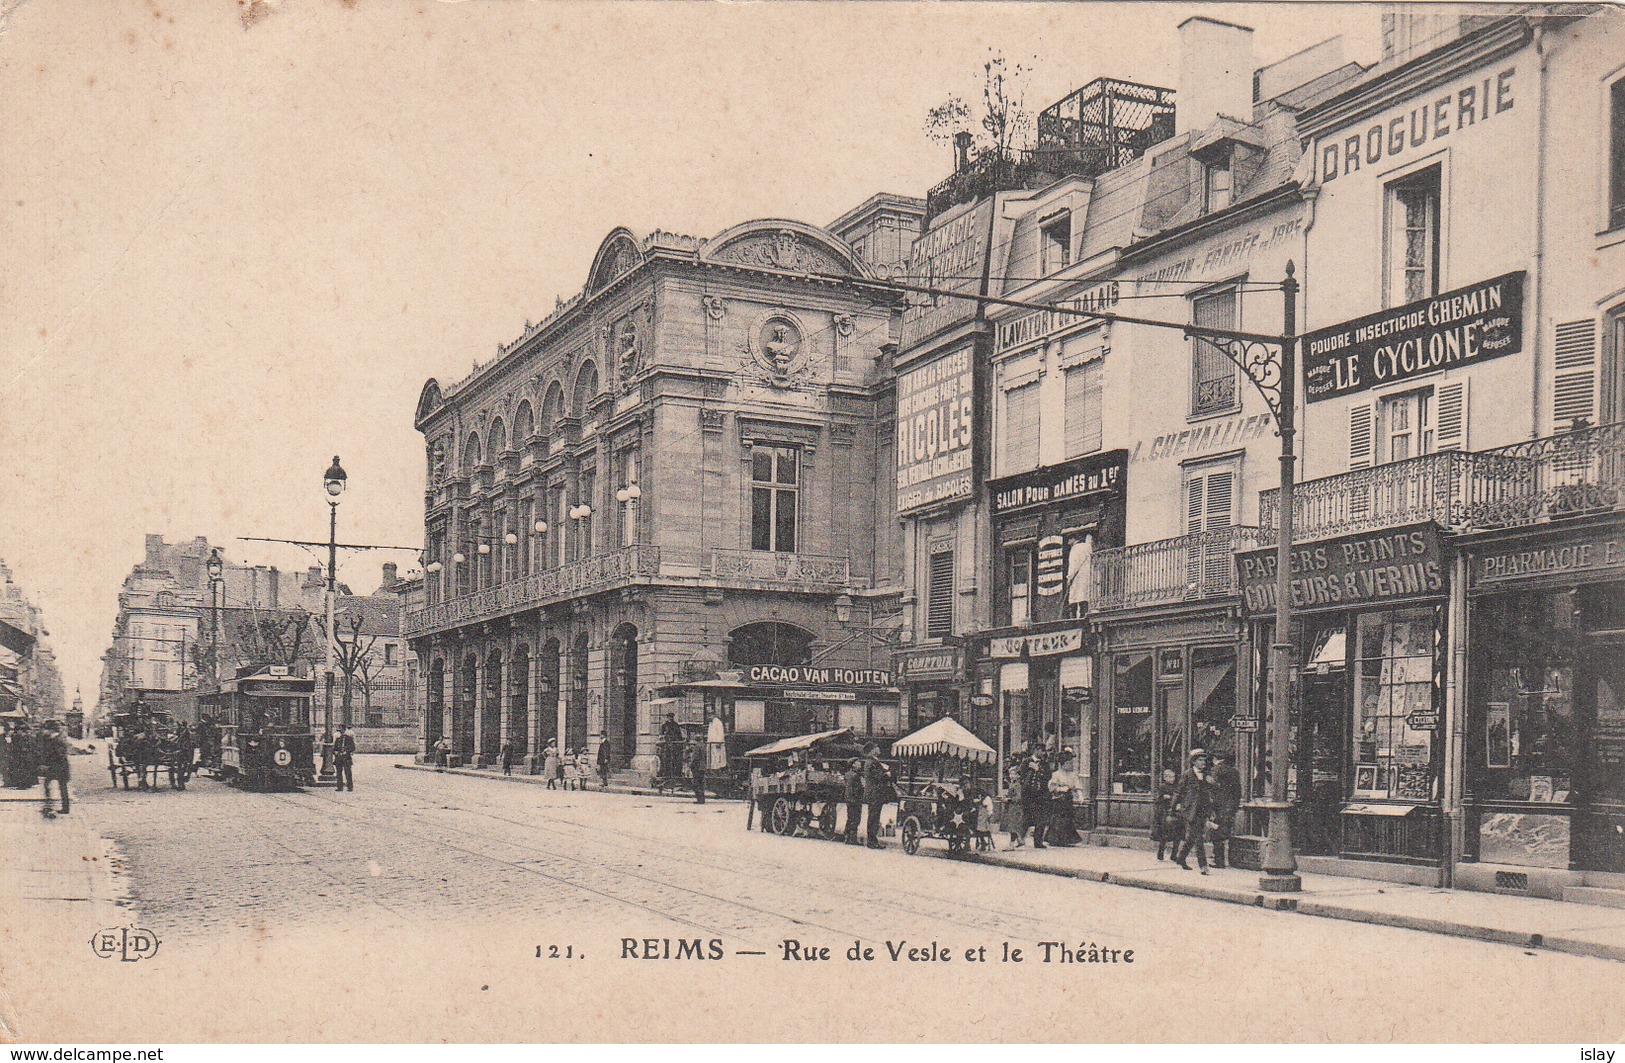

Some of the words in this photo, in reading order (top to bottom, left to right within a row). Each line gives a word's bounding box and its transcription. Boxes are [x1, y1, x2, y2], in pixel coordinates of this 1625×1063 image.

[1322, 67, 1516, 184] DROGUERIE
[1002, 310, 1055, 350] LAVATORY
[1310, 331, 1351, 356] POUDRE
[1355, 309, 1426, 344] INSECTICIDE
[1427, 284, 1503, 327] CHEMIN
[1149, 412, 1272, 463] CHEVALLIER
[996, 488, 1024, 509] SALON
[1053, 473, 1086, 498] DAMES
[1087, 475, 1099, 490] au
[1243, 547, 1330, 580] PAPERS
[1341, 531, 1426, 565] PEINTS
[1484, 544, 1593, 578] PHARMACIE
[1244, 573, 1344, 612] COUEURS
[1360, 561, 1443, 598] VERNIS
[750, 666, 800, 682] CACAO
[803, 667, 829, 683] VAN
[834, 668, 890, 685] HOUTEN
[907, 655, 953, 669] COMPTOIR
